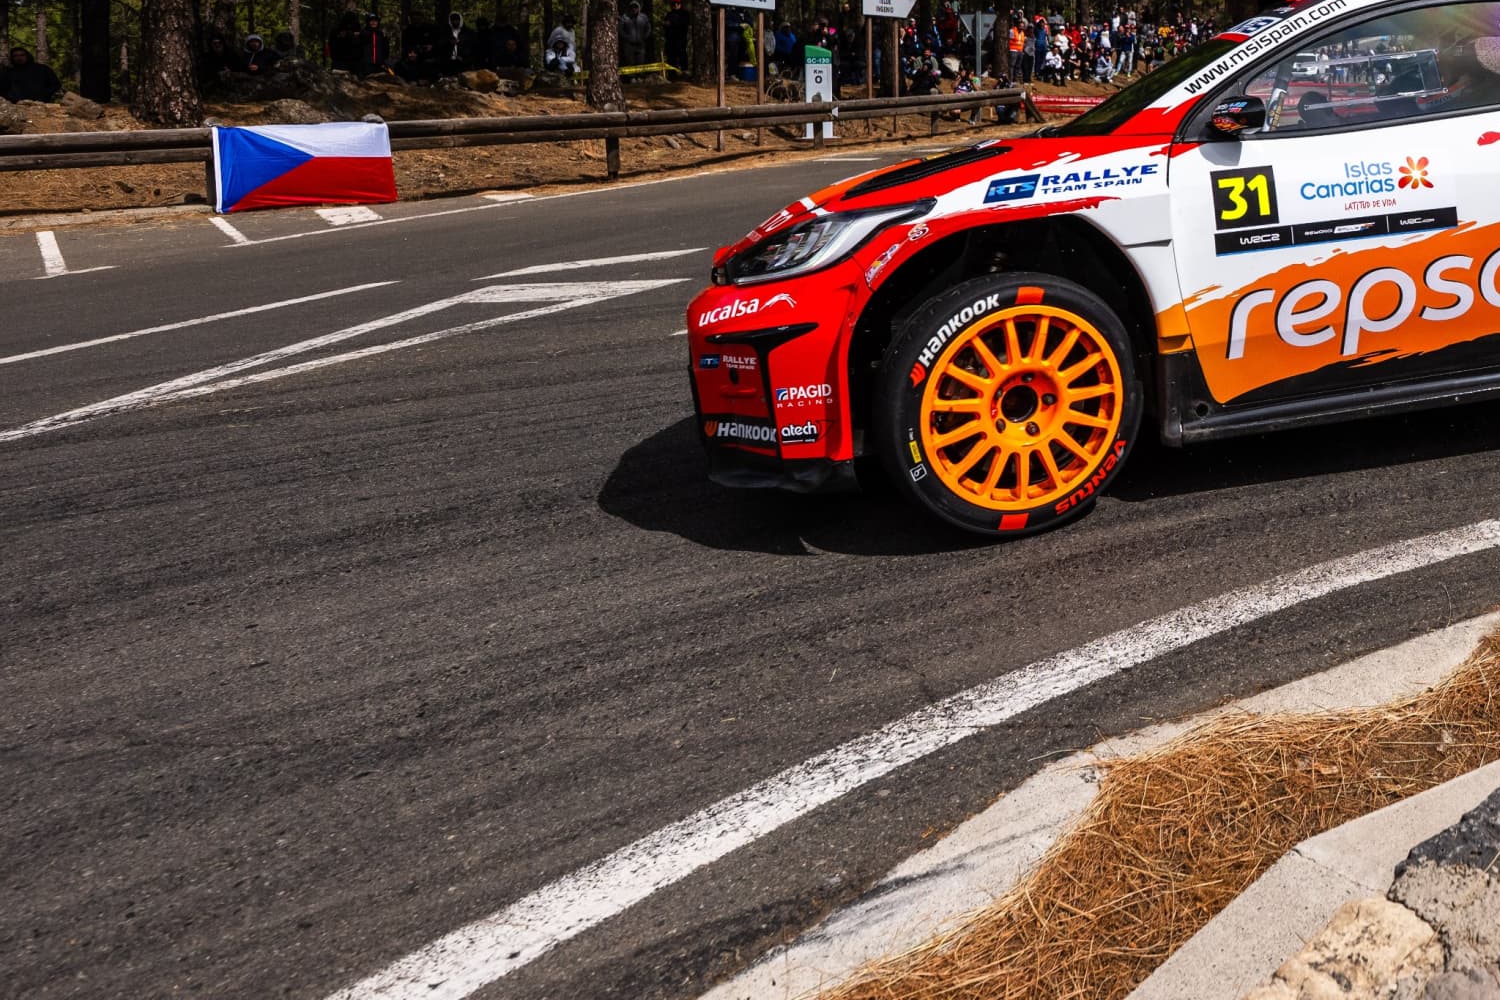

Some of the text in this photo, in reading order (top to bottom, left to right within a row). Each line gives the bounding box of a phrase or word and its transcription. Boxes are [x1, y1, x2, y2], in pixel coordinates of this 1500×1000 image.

[1184, 0, 1347, 95] www.msispain.com
[815, 75, 823, 84] 0
[1041, 164, 1158, 186] RALLYE
[1344, 160, 1393, 178] Islas
[988, 181, 1036, 197] RTS
[1041, 177, 1143, 195] TEAM SPAIN
[1300, 177, 1395, 200] Canarias
[1216, 174, 1273, 221] 31
[1373, 199, 1380, 207] DE
[1382, 198, 1397, 207] VIDA
[698, 298, 760, 327] ucalsa
[723, 355, 757, 365] RALLYE
[789, 384, 832, 400] PAGID
[776, 399, 833, 408] RACING
[781, 421, 818, 437] atech
